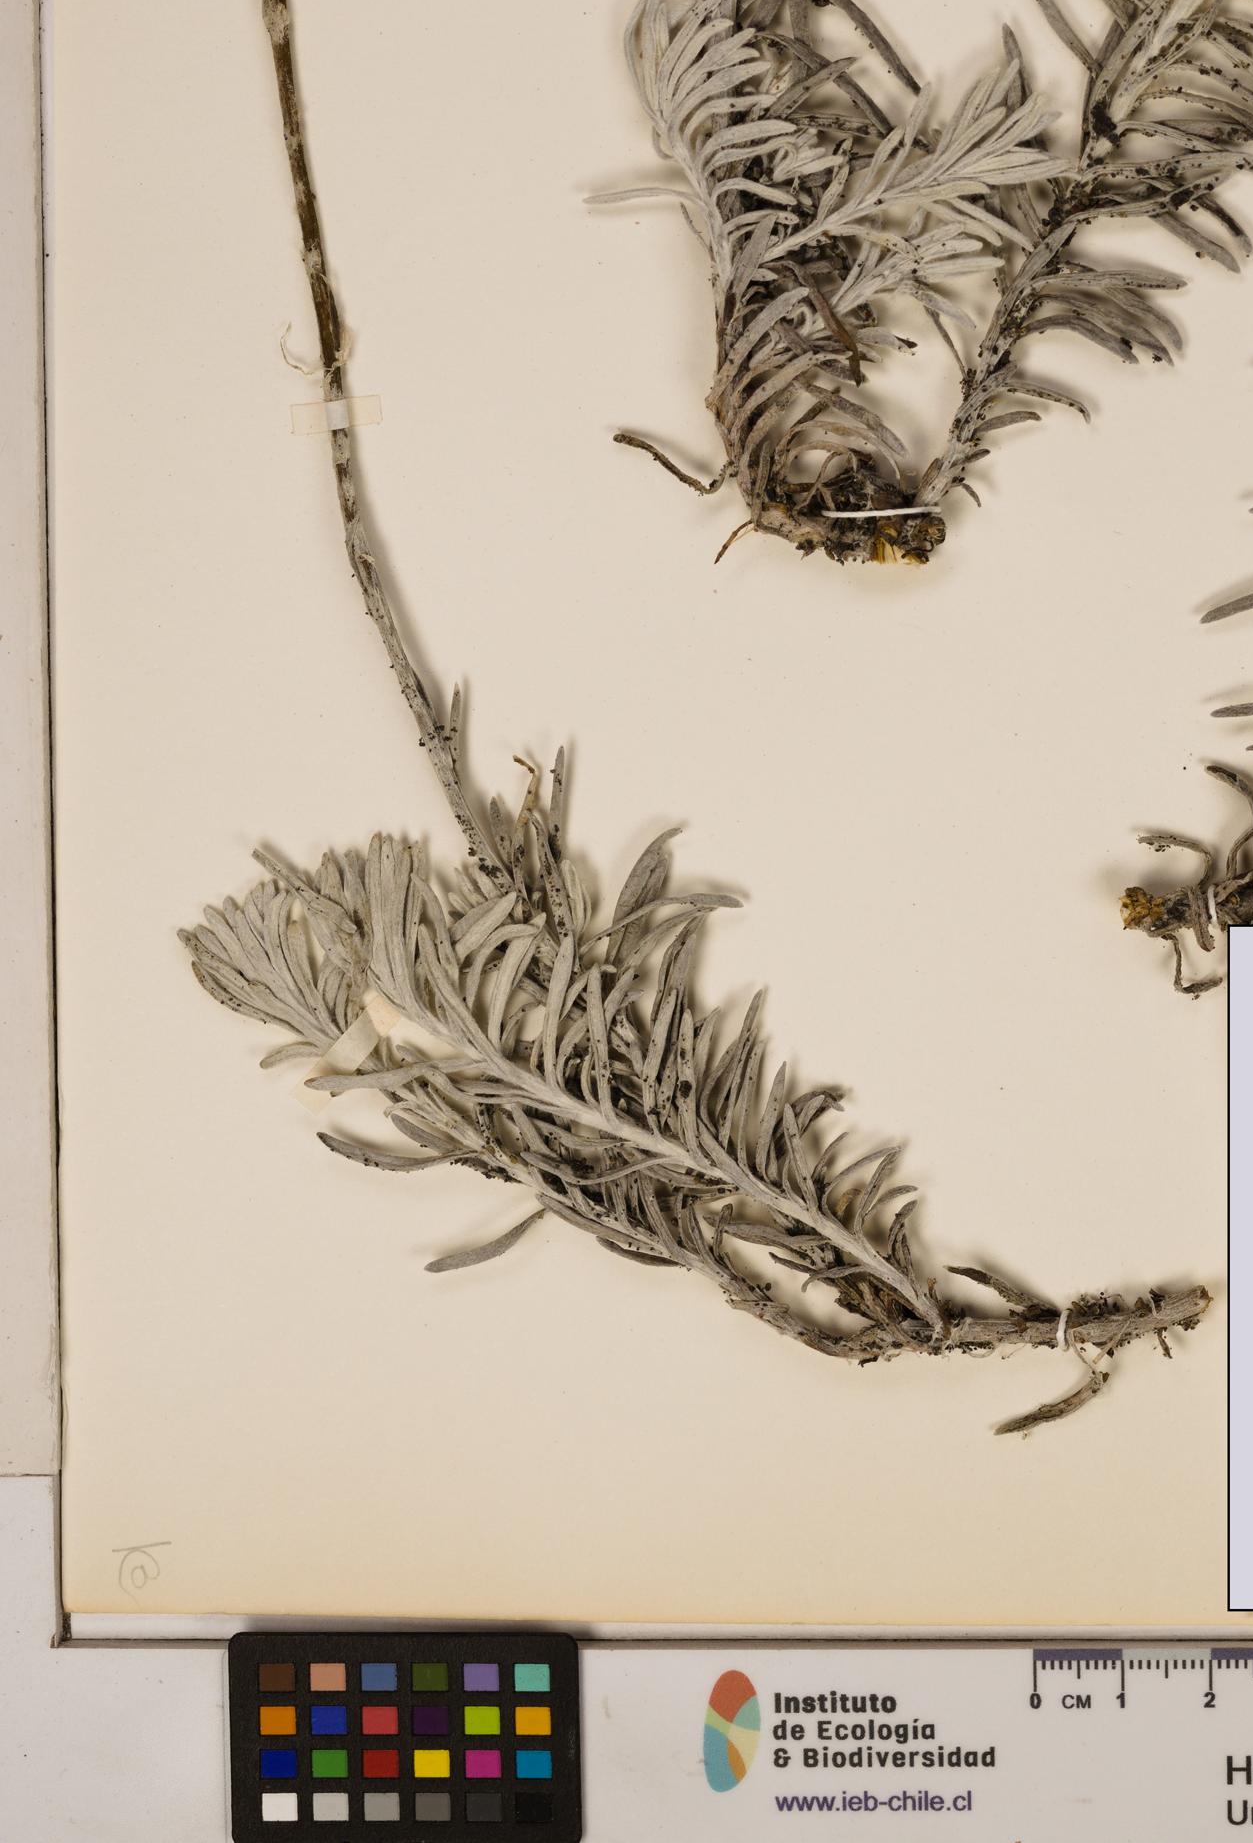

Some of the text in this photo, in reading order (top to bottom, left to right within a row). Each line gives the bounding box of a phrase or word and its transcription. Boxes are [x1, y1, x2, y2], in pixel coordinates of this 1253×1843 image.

[773, 1690, 898, 1714] Instituto
[1028, 1692, 1042, 1710] 0
[1061, 1694, 1092, 1710] CM
[1115, 1692, 1126, 1709] 1
[1202, 1691, 1217, 1709] 2
[772, 1718, 936, 1745] de Ecología
[772, 1745, 997, 1769] & Biodiversidad
[774, 1789, 973, 1812] www.ieb-chile.cl
